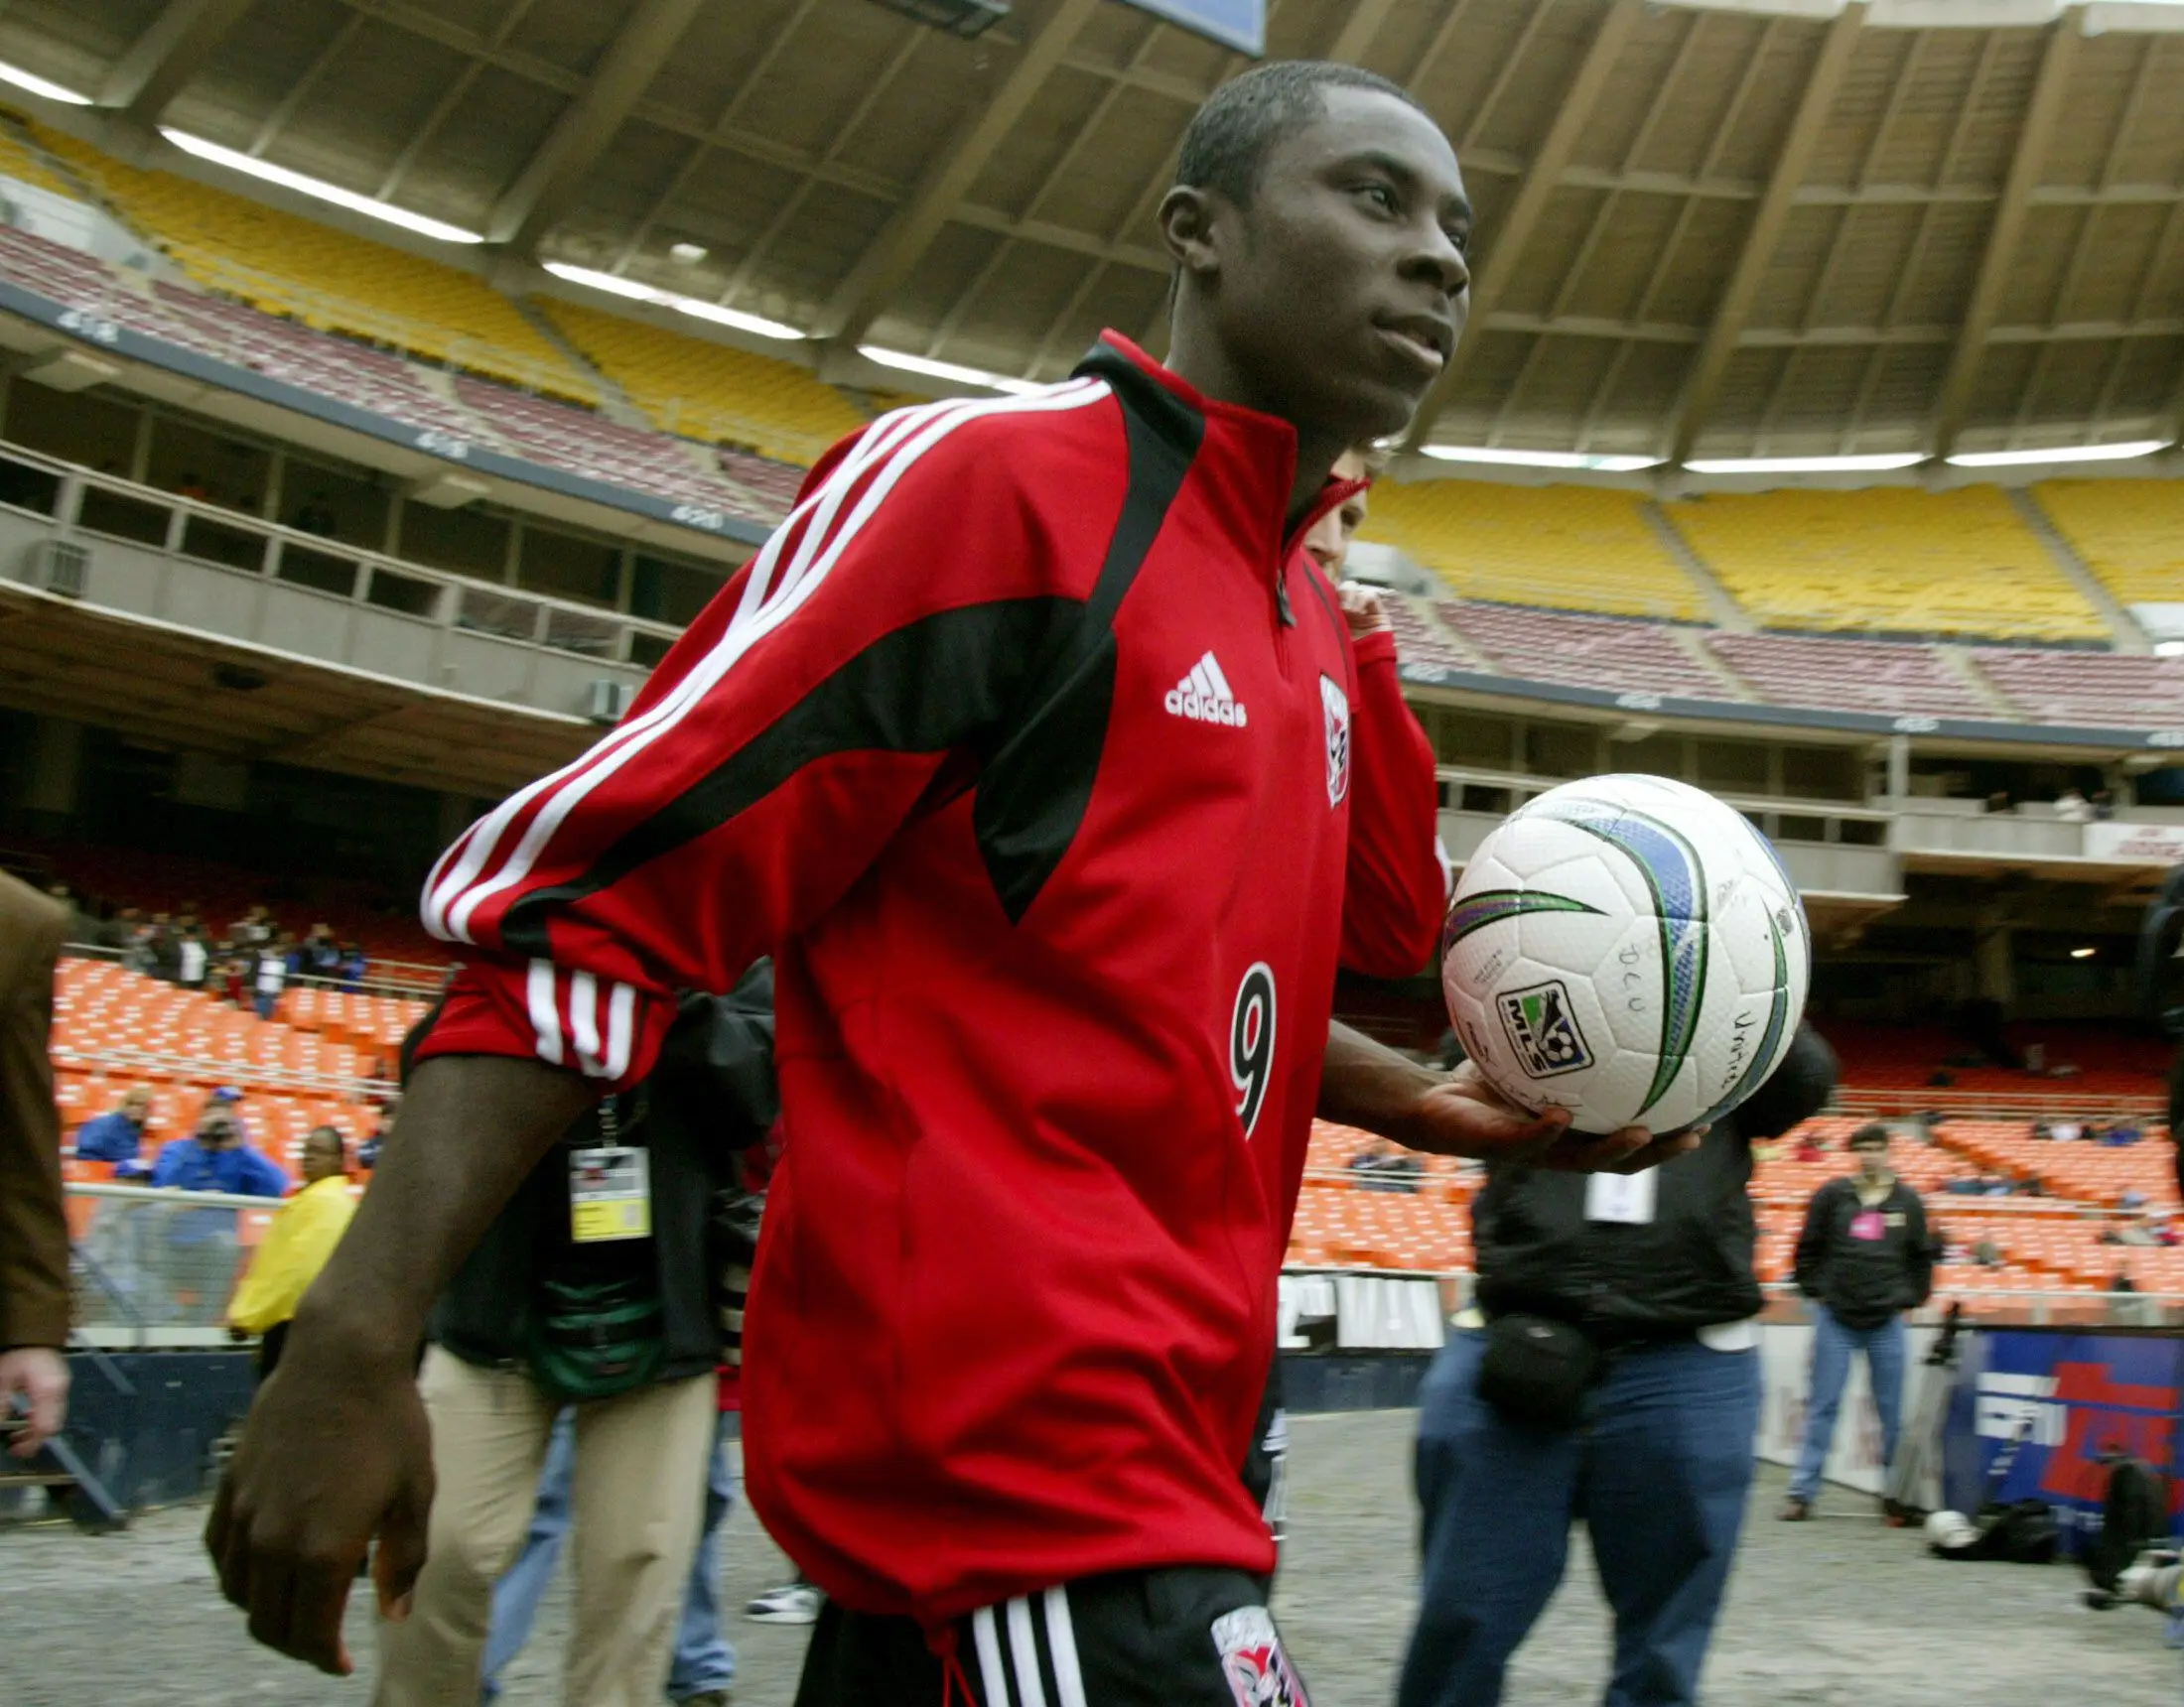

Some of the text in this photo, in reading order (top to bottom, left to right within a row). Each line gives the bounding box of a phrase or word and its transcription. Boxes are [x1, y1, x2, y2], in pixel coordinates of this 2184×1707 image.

[1164, 689, 1247, 727] adidas
[1229, 961, 1277, 1142] 9
[1507, 997, 1549, 1072] MLS
